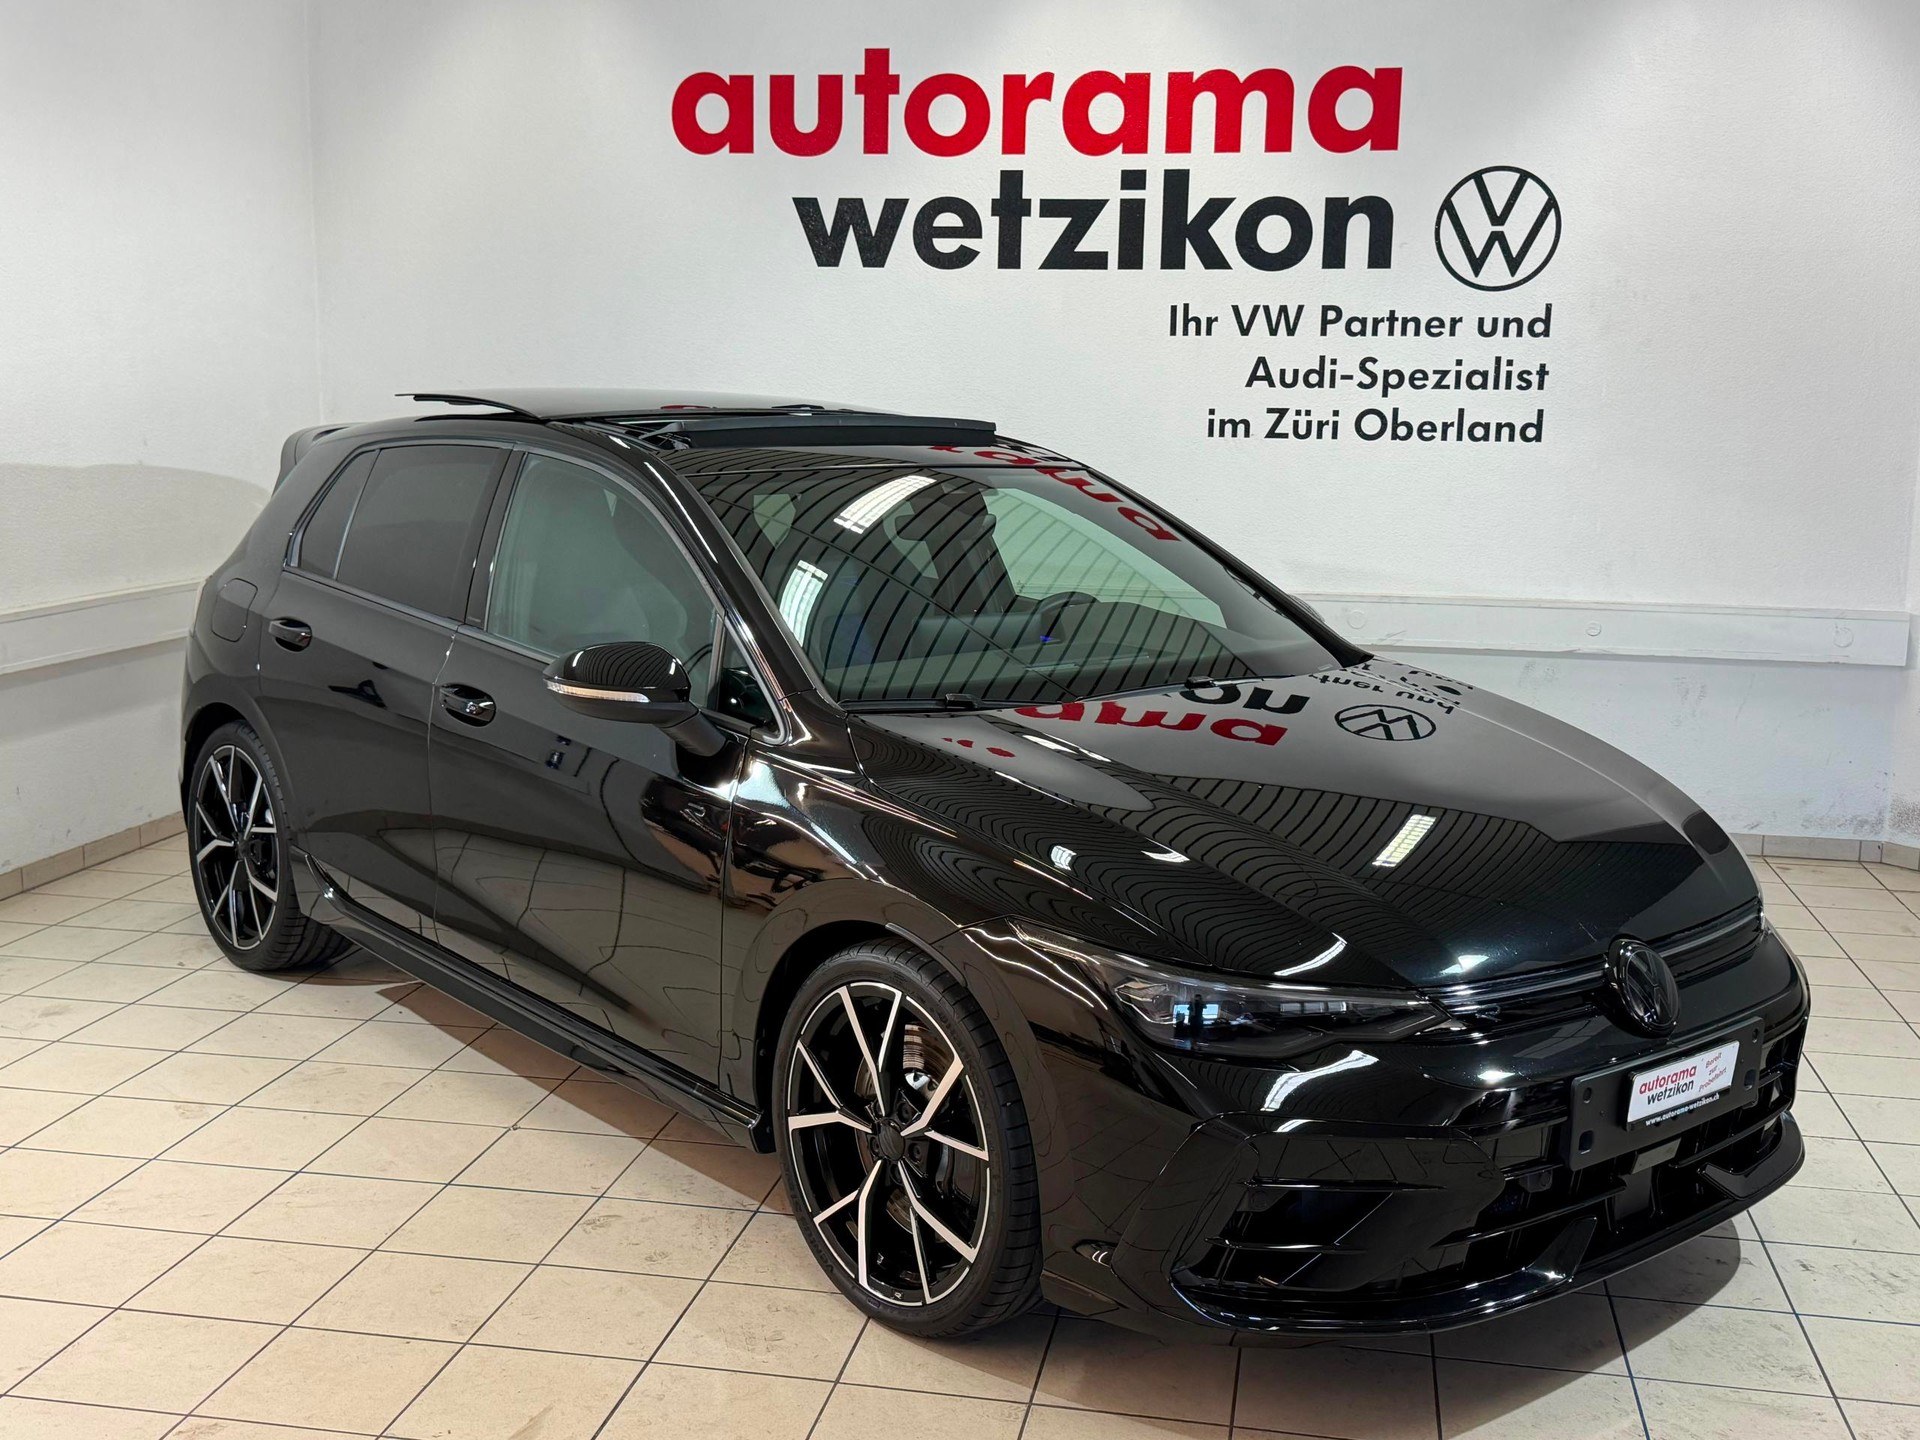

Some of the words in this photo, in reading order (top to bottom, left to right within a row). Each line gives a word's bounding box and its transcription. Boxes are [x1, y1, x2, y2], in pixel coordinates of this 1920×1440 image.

[672, 48, 1402, 157] autorama
[792, 169, 1393, 271] wetzikon
[1170, 303, 1218, 337] Ihr
[1232, 305, 1304, 336] VW
[1321, 305, 1462, 337] Partner
[1478, 304, 1552, 337] und
[1245, 356, 1549, 397] Audi-Spezialist
[1208, 409, 1250, 438] im
[1265, 408, 1339, 439] Züri
[1355, 408, 1543, 442] Oberland
[1639, 1065, 1697, 1095] autorama
[1647, 1079, 1694, 1105] wetzikon
